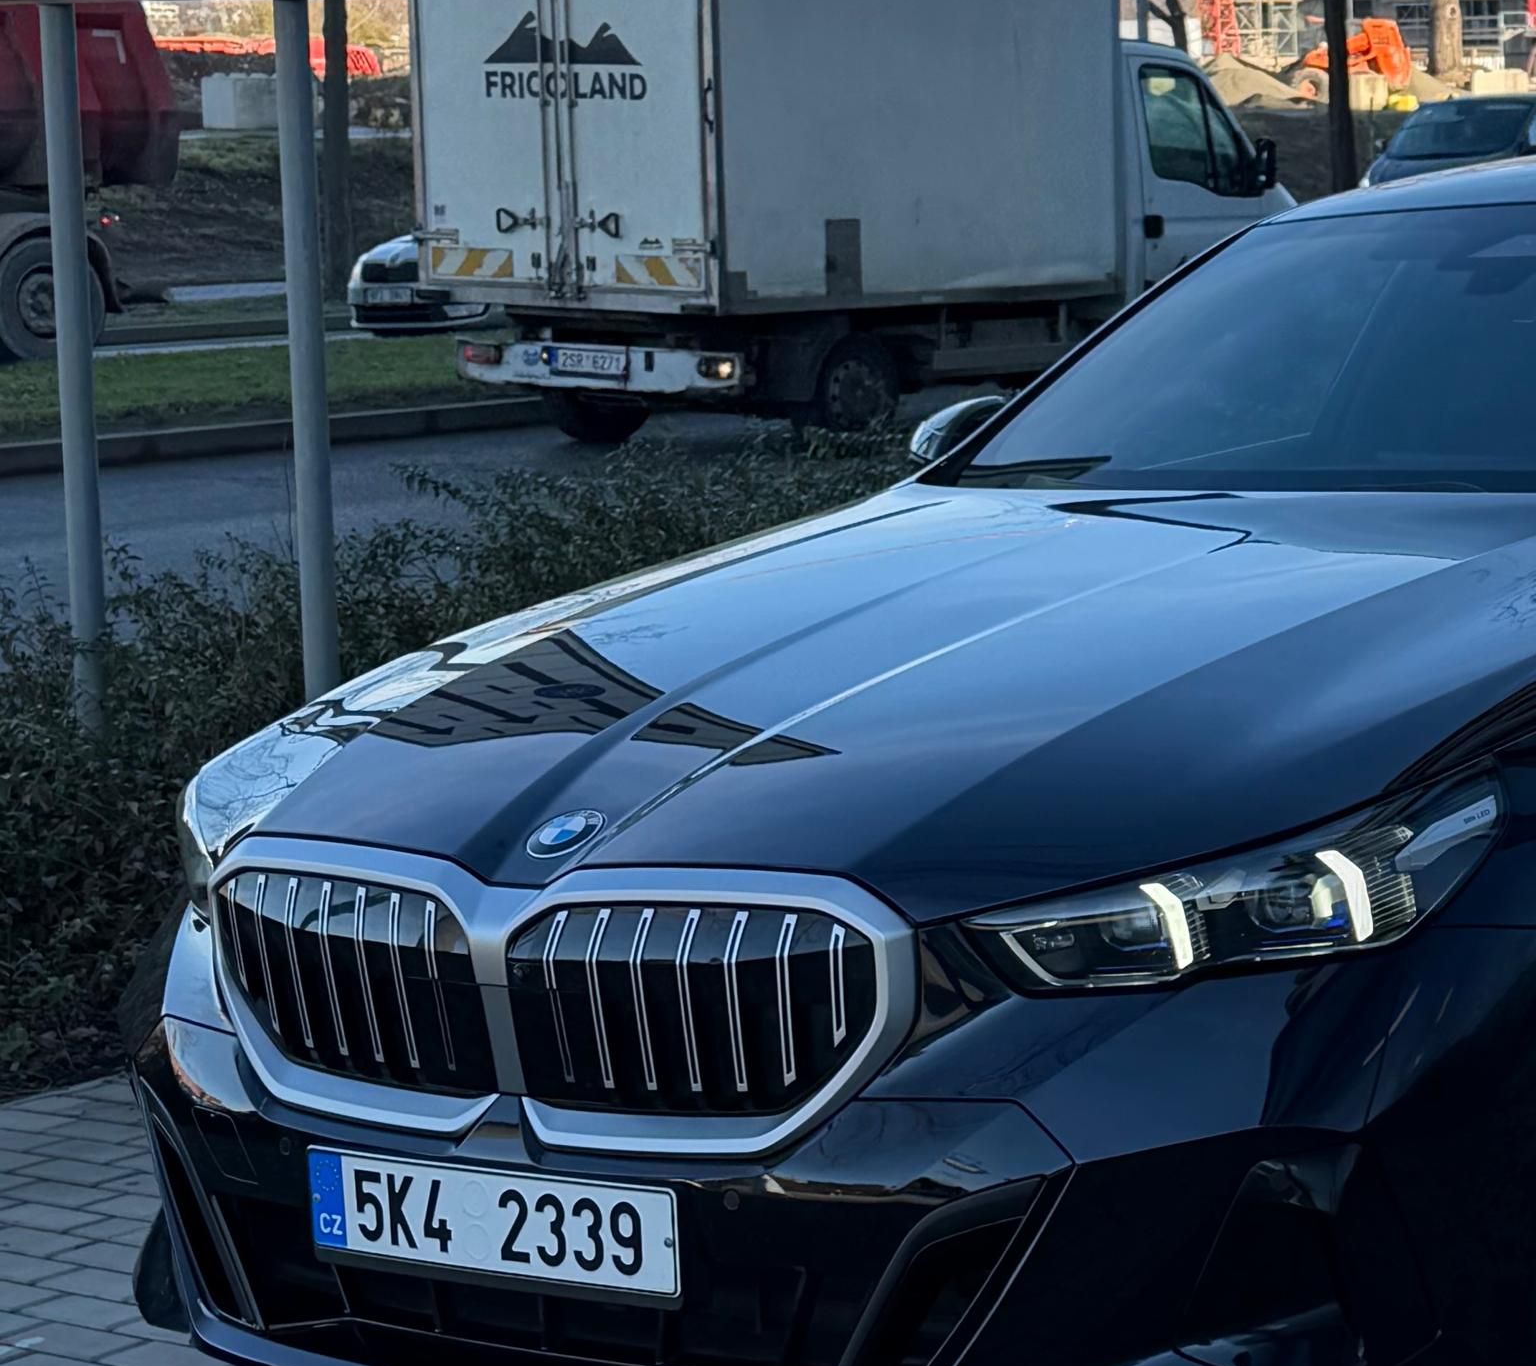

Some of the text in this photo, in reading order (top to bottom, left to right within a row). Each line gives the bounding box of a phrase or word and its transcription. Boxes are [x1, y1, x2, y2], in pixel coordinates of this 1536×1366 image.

[320, 1212, 343, 1236] CZ
[353, 1168, 644, 1276] 5K4 2339
